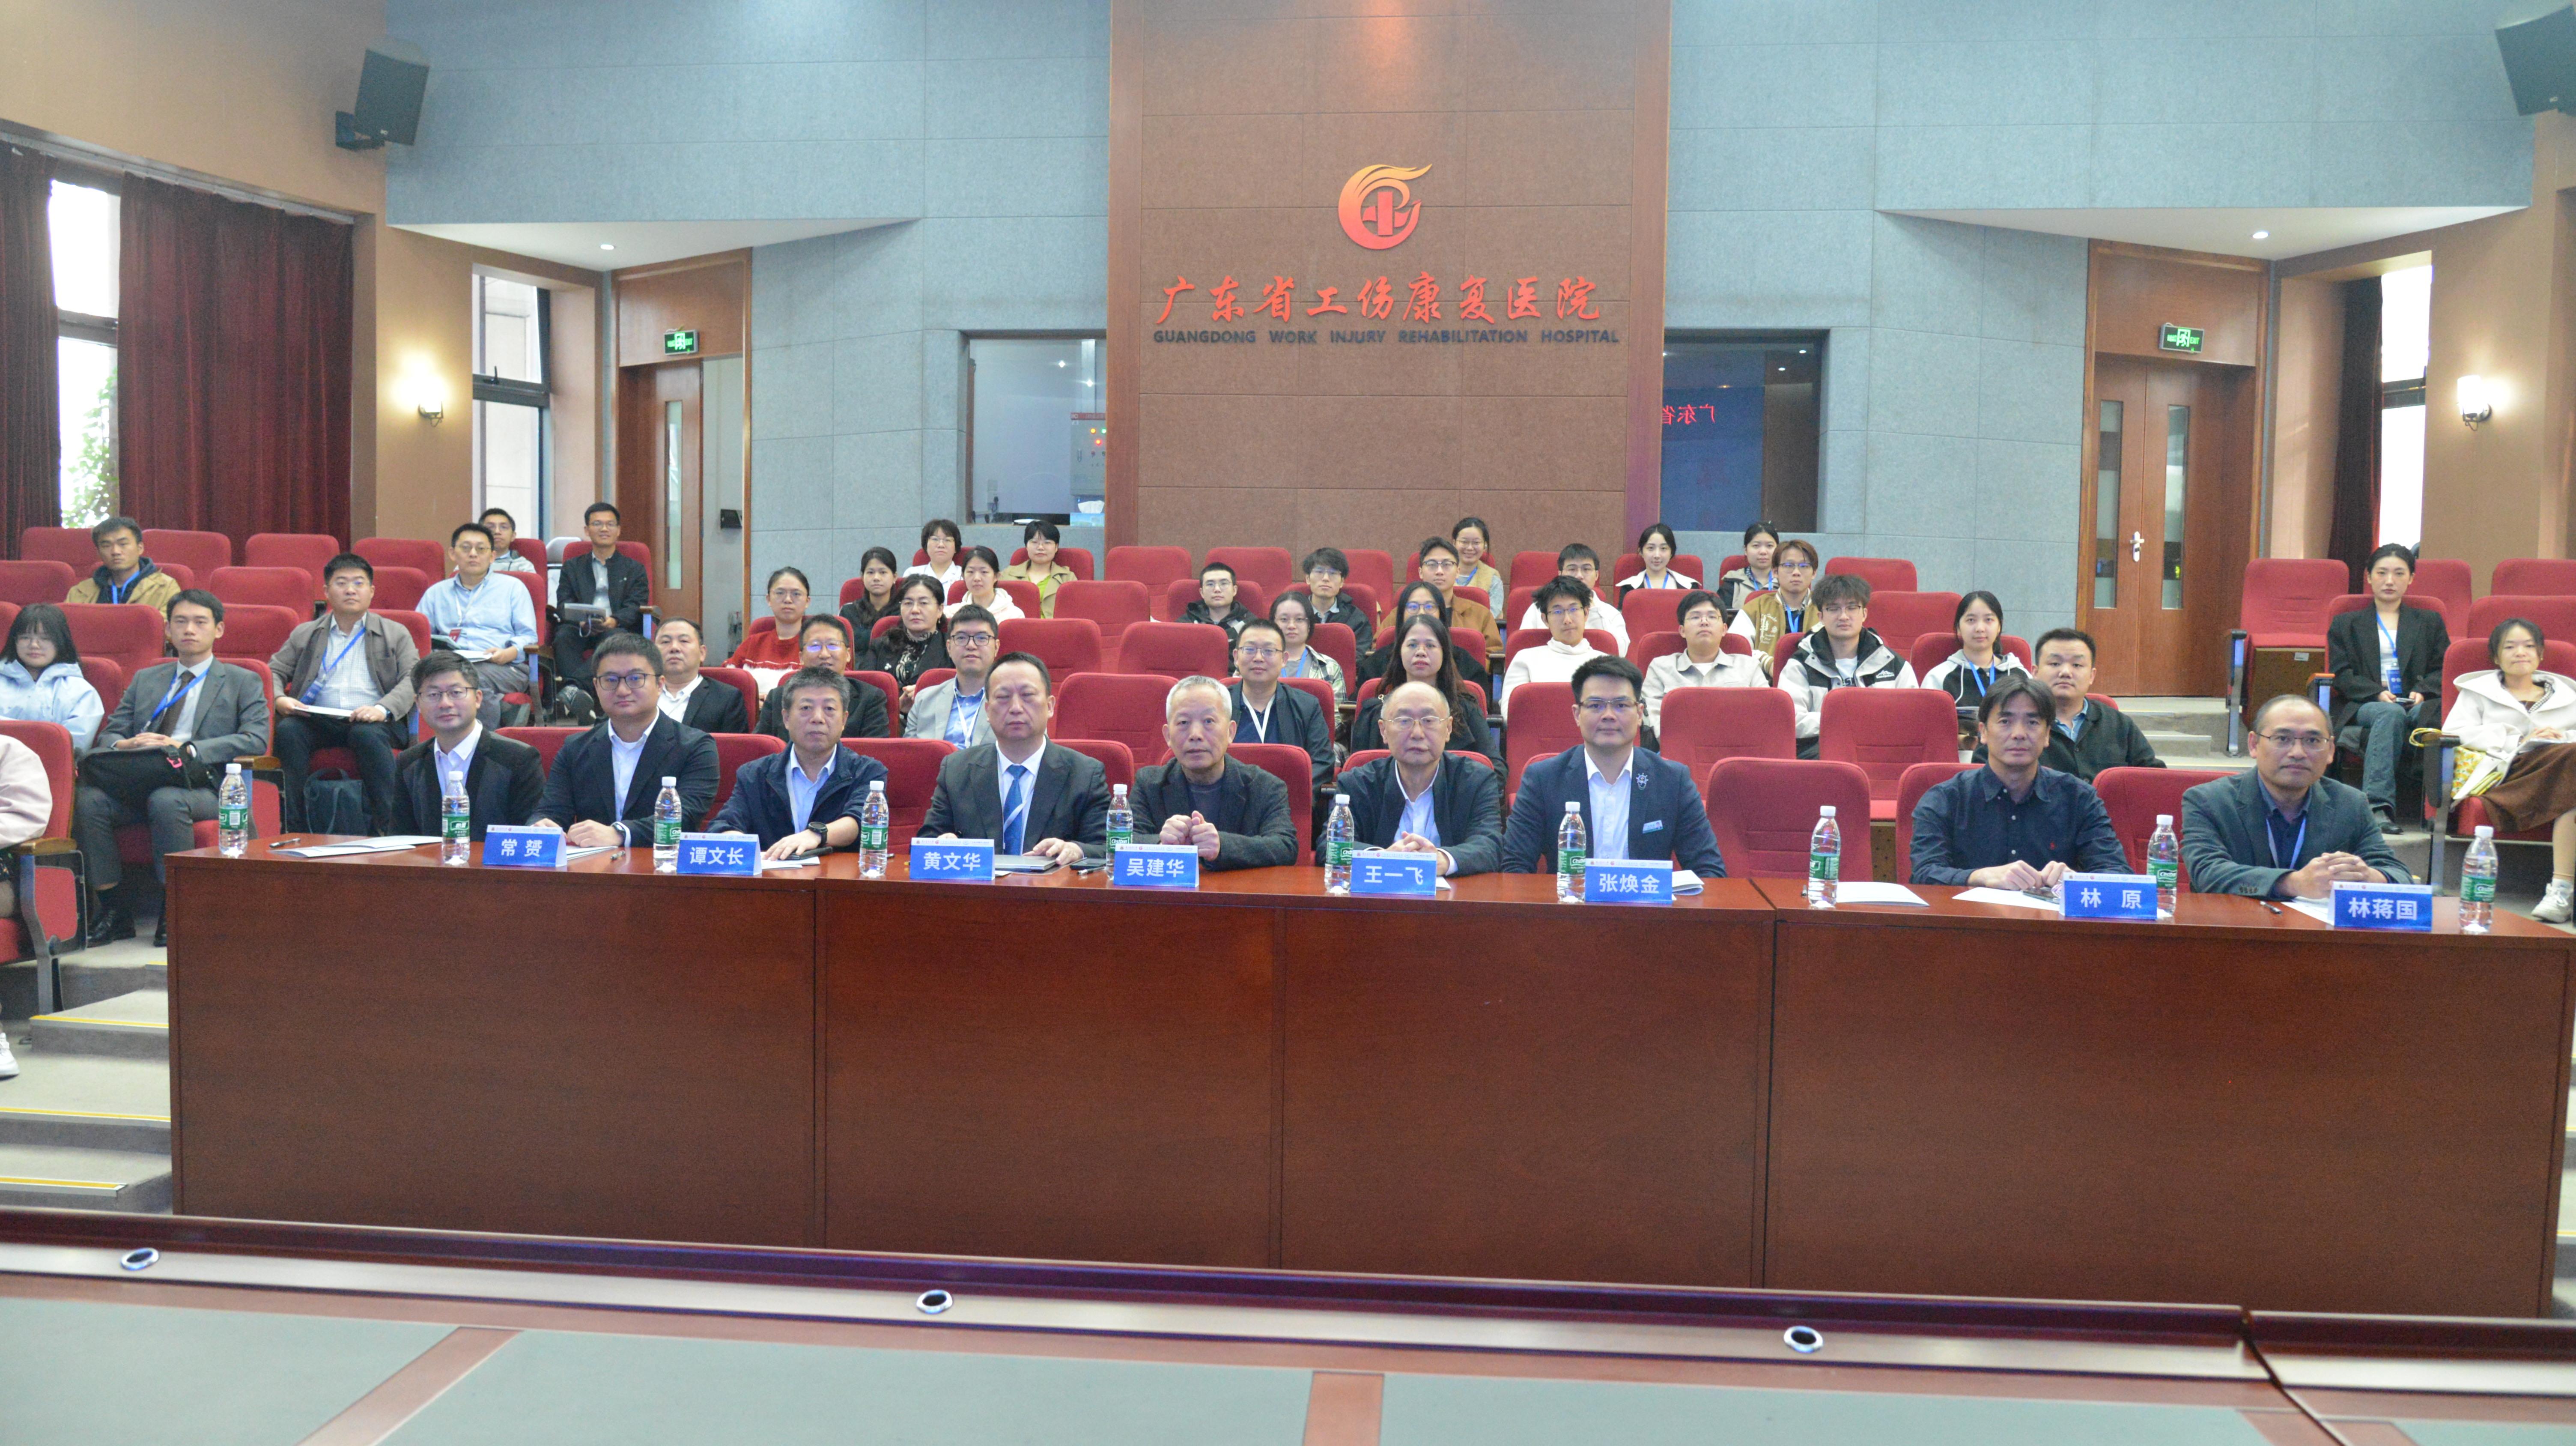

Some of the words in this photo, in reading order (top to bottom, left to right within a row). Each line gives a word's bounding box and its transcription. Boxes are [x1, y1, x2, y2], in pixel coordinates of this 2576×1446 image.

[1156, 272, 1601, 324] 广东省工伤康复医院
[1153, 330, 1256, 345] GUANGDONG
[1269, 330, 1318, 345] WORK
[1330, 330, 1386, 345] INJURY
[1398, 330, 1528, 344] REHABILITATION
[1541, 329, 1619, 344] HOSPITAL
[689, 847, 744, 866] 谭文长
[923, 851, 981, 872] 黄文华
[1127, 858, 1185, 878] 吴建华
[1363, 865, 1424, 885] 王一飞
[1599, 873, 1661, 894] 张焕金
[2080, 887, 2142, 910] 林原
[2348, 897, 2418, 921] 林蒋国
